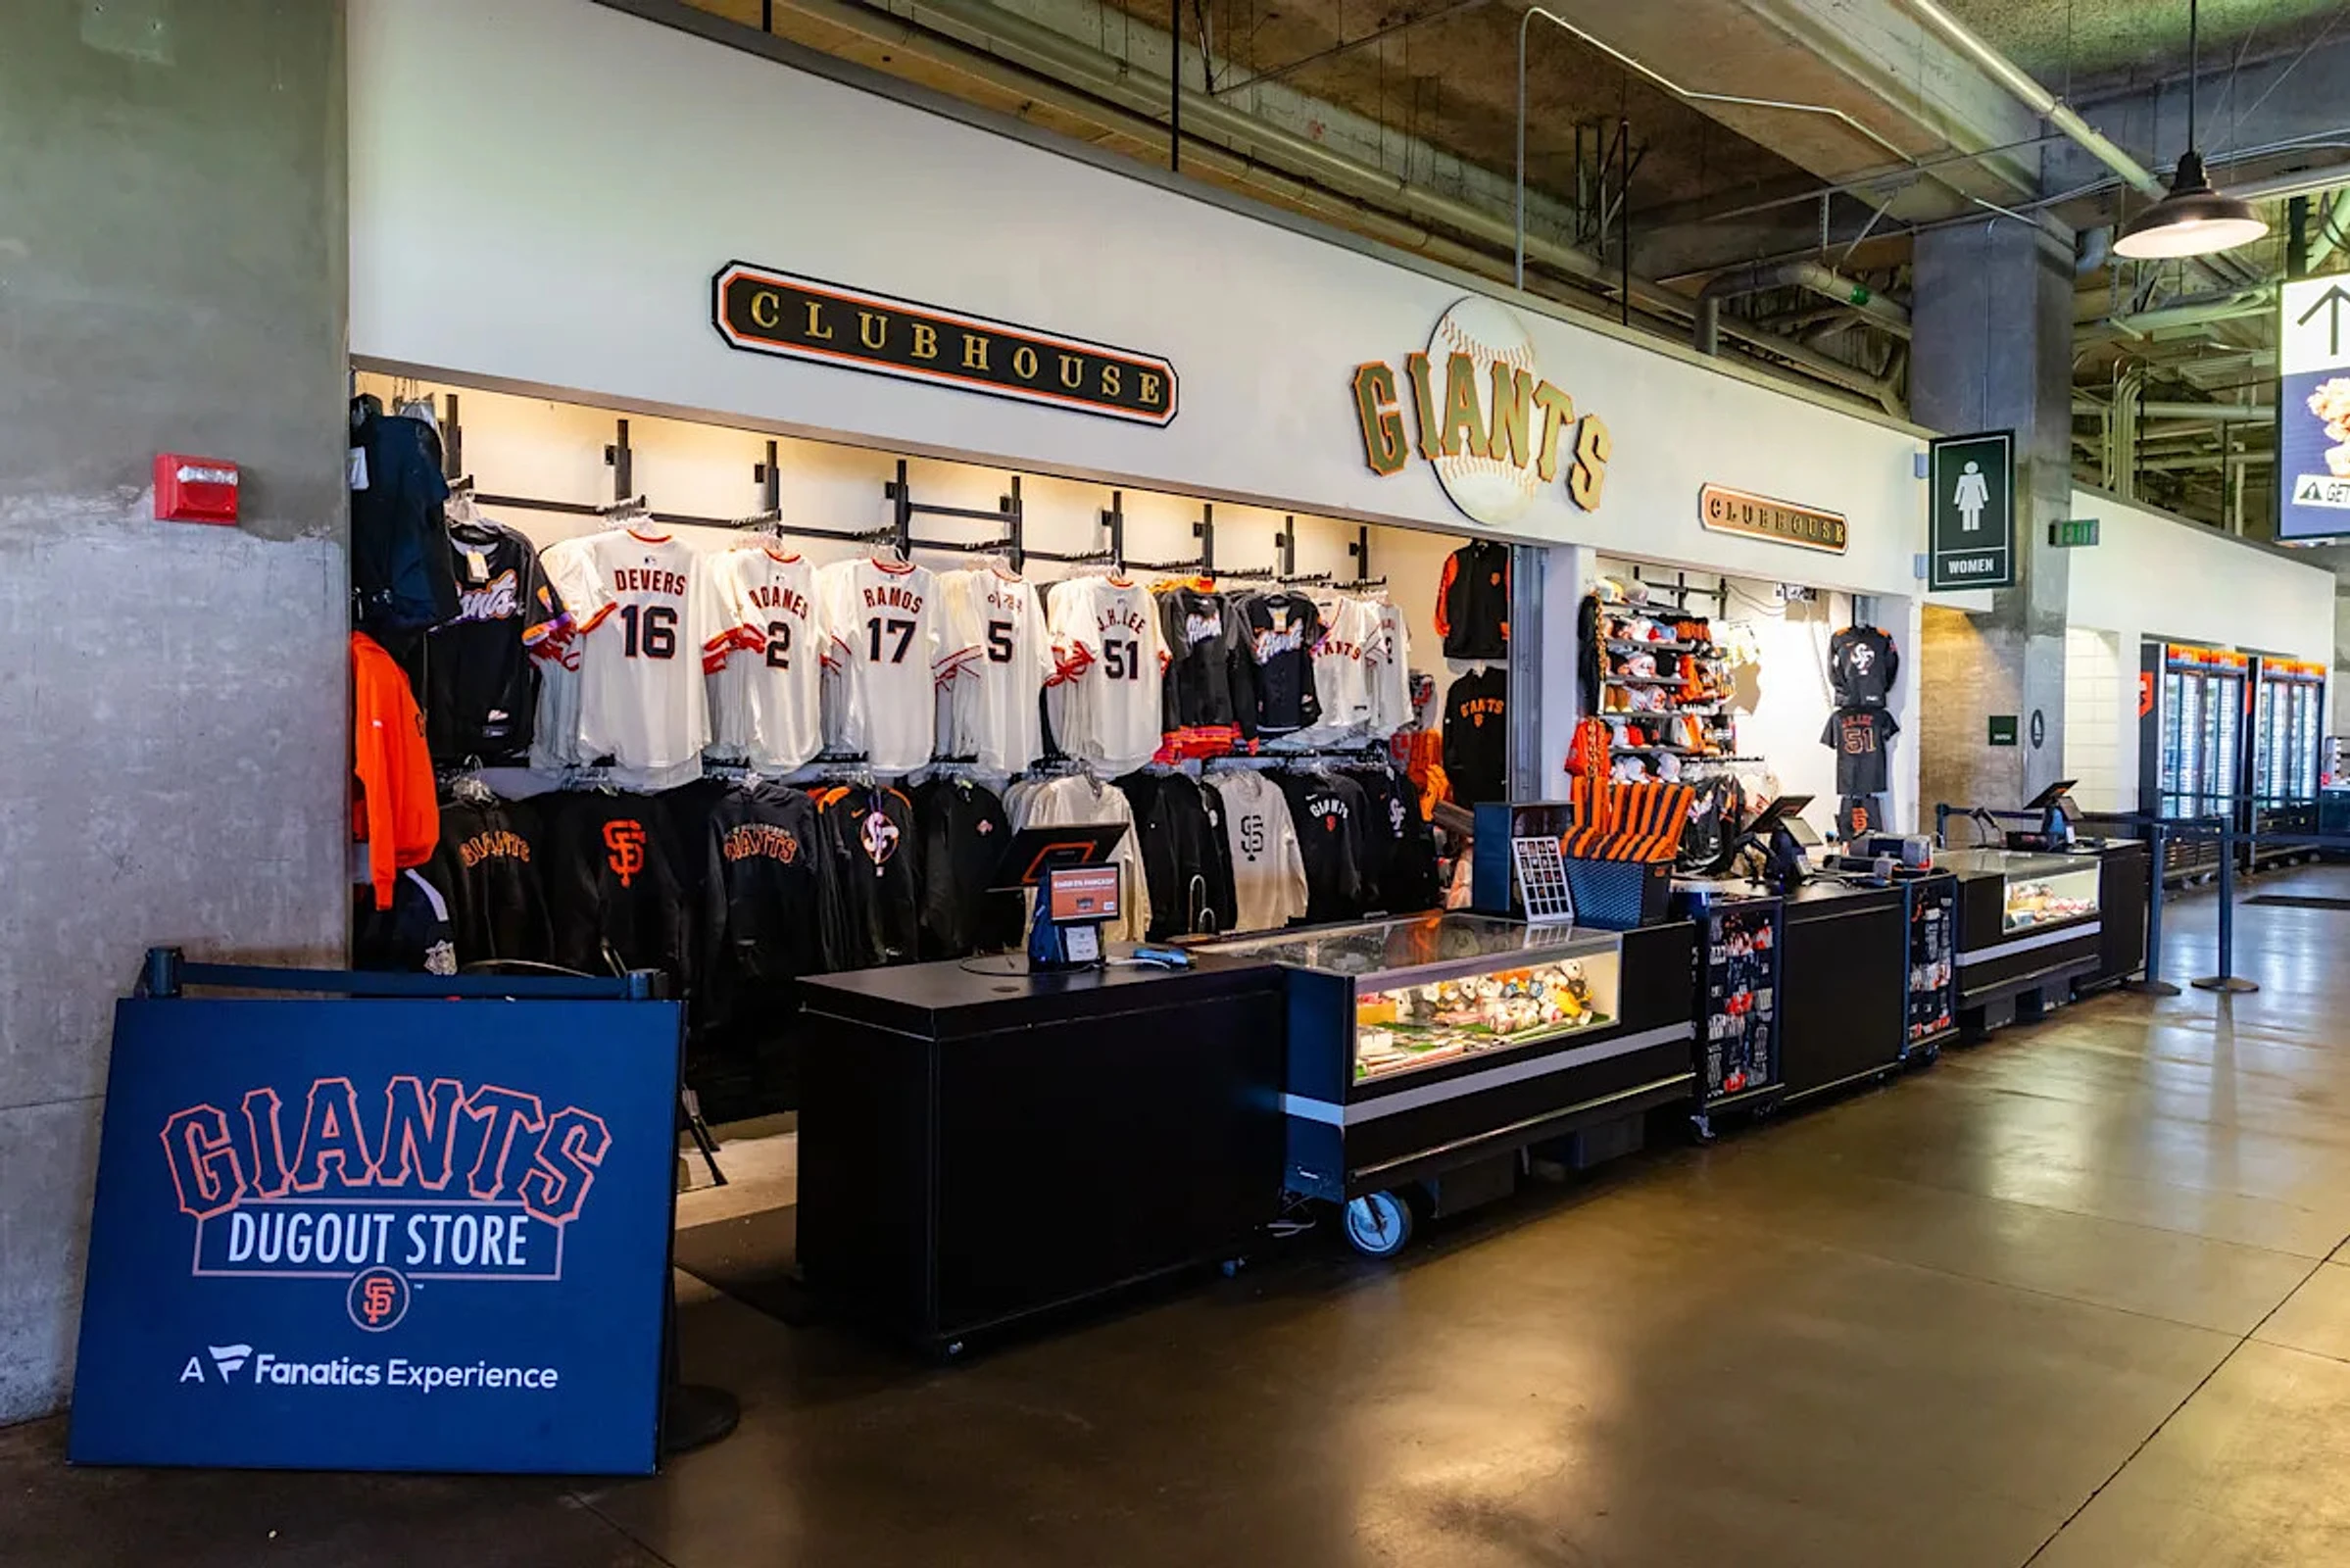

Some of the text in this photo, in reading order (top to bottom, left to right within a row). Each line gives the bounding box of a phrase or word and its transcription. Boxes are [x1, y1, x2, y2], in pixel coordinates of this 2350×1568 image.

[751, 291, 1160, 405] CLUBHOUSE
[1353, 351, 1612, 514] GIANTS
[1710, 498, 1843, 542] CLUBHOUSE
[614, 568, 686, 596] DEVERS
[1948, 558, 1994, 574] WOMEN
[863, 586, 923, 614] RAMOS
[620, 605, 679, 660] 16
[766, 620, 791, 669] 2
[867, 617, 917, 663] 17
[1104, 639, 1138, 679] 51
[1844, 728, 1876, 754] 51
[603, 819, 647, 889] SF
[160, 1076, 612, 1224] GIANTS
[228, 1212, 528, 1267] DUGOUT STORE
[364, 1277, 396, 1324] SF
[180, 1353, 559, 1394] A Fanatics Experience
